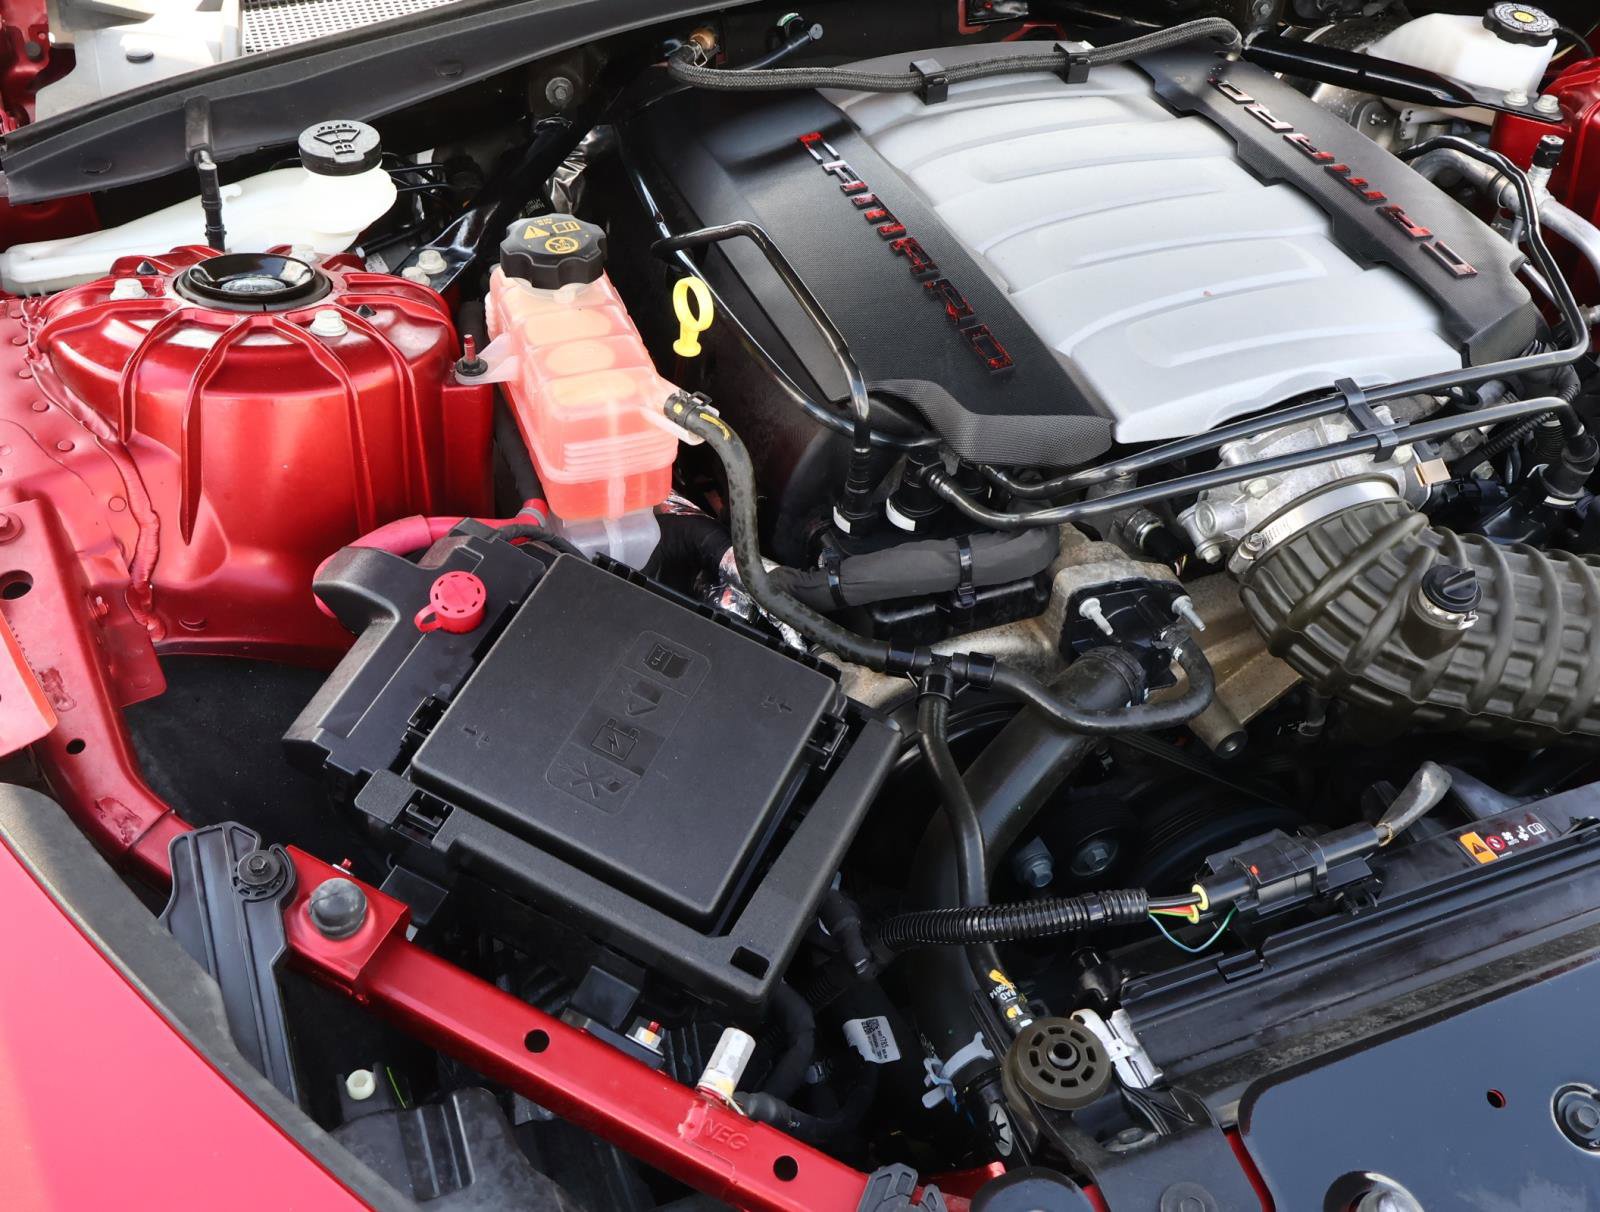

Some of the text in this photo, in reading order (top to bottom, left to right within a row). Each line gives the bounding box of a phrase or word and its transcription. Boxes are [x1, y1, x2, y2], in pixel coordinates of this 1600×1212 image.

[797, 131, 1016, 375] CAMARO
[1207, 76, 1477, 279] CAMARO
[703, 1119, 749, 1150] NEG
